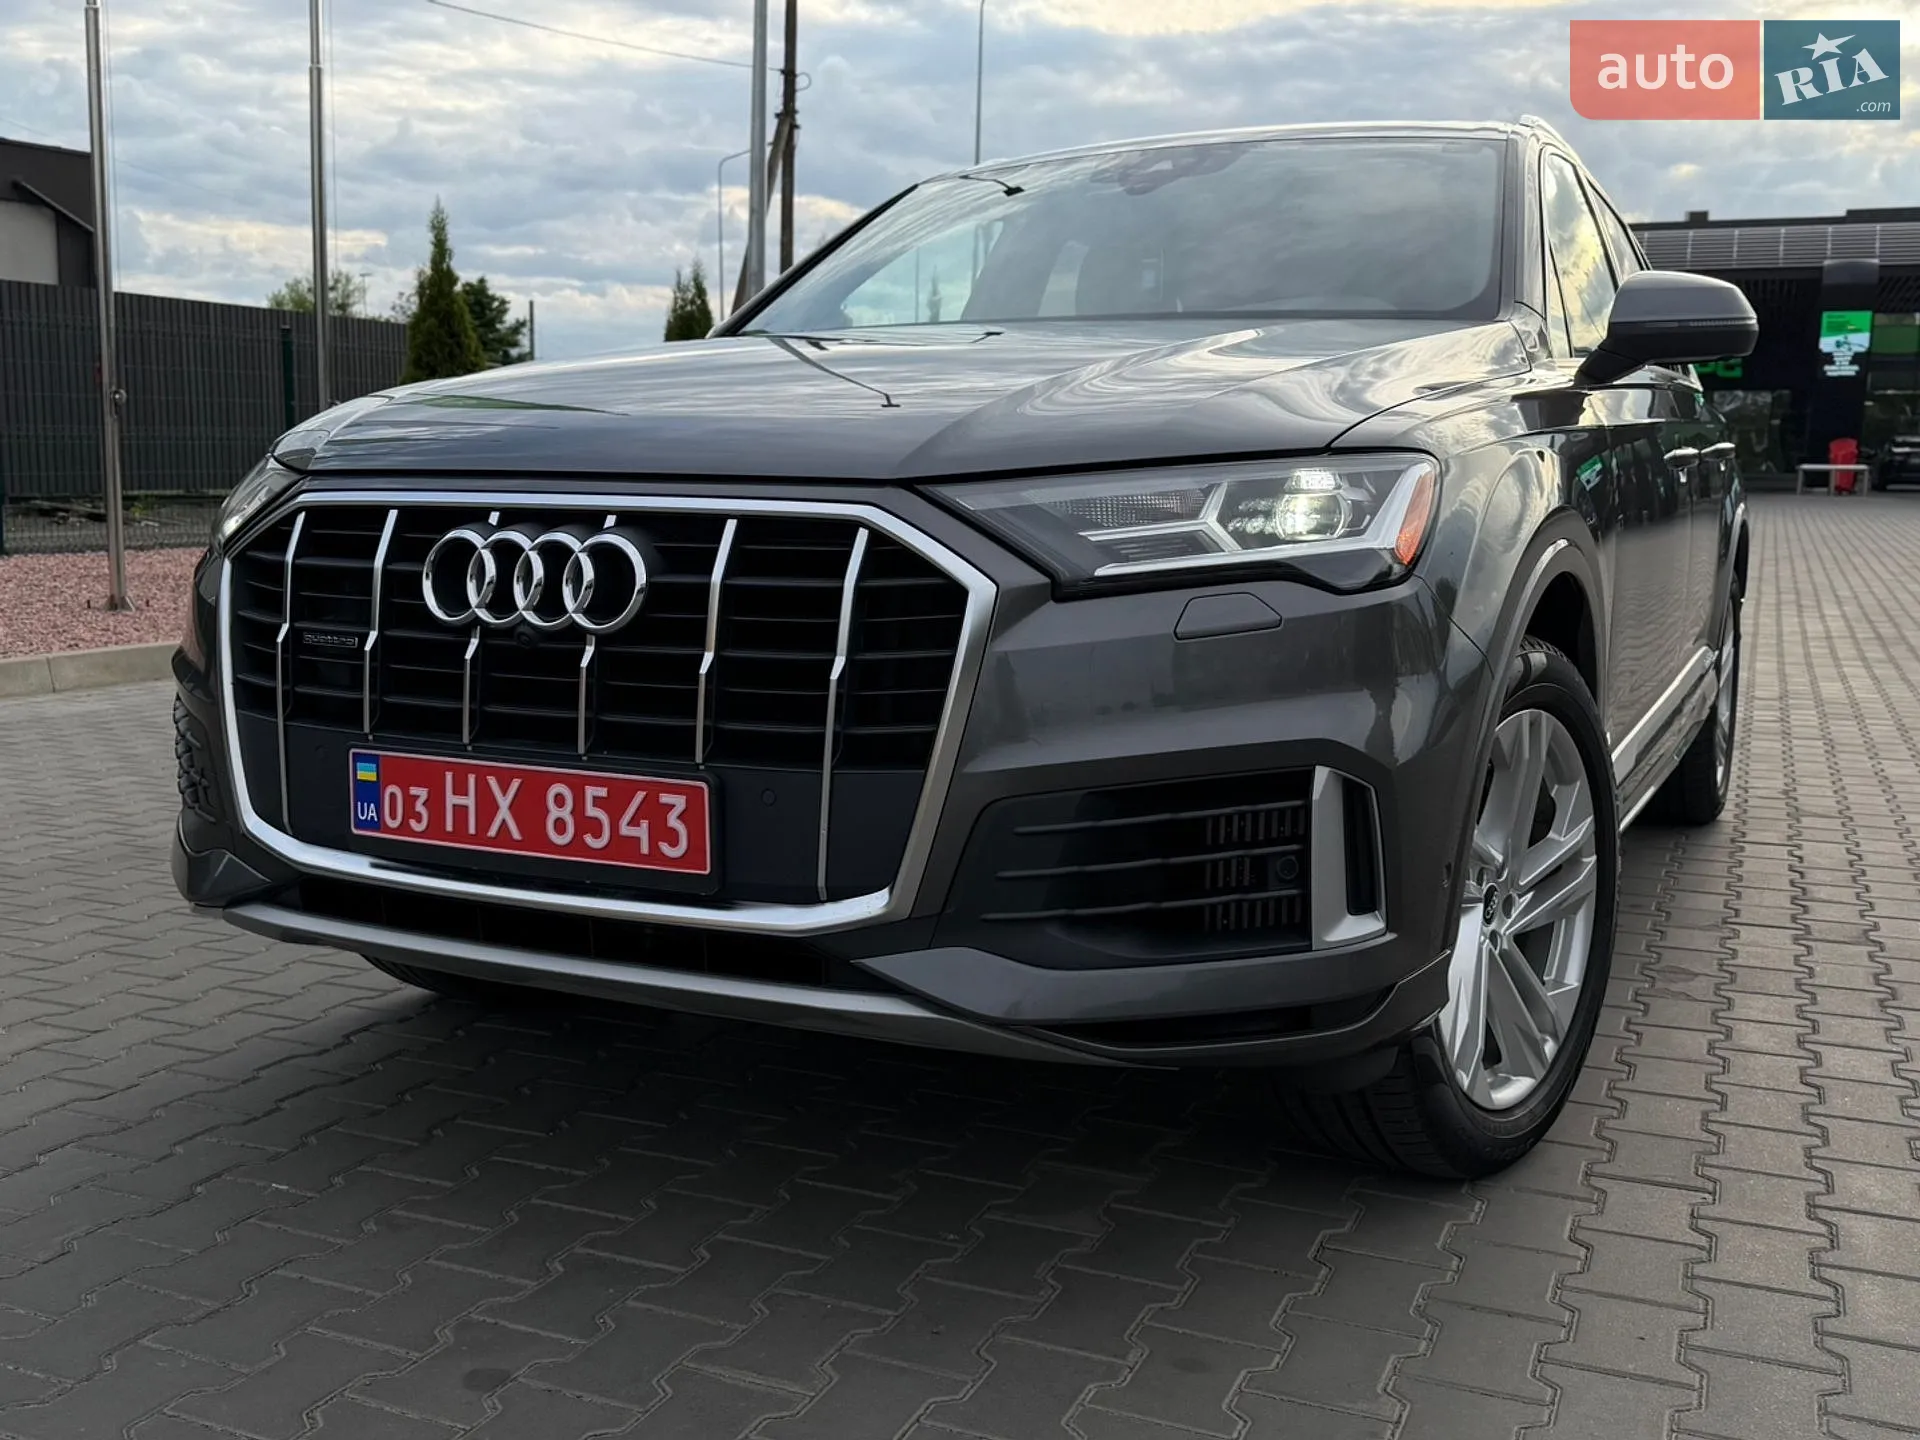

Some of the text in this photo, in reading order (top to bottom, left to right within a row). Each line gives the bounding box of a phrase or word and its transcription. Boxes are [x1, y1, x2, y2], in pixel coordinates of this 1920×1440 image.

[357, 801, 378, 822] UA
[383, 771, 689, 858] 03 HX 8543
